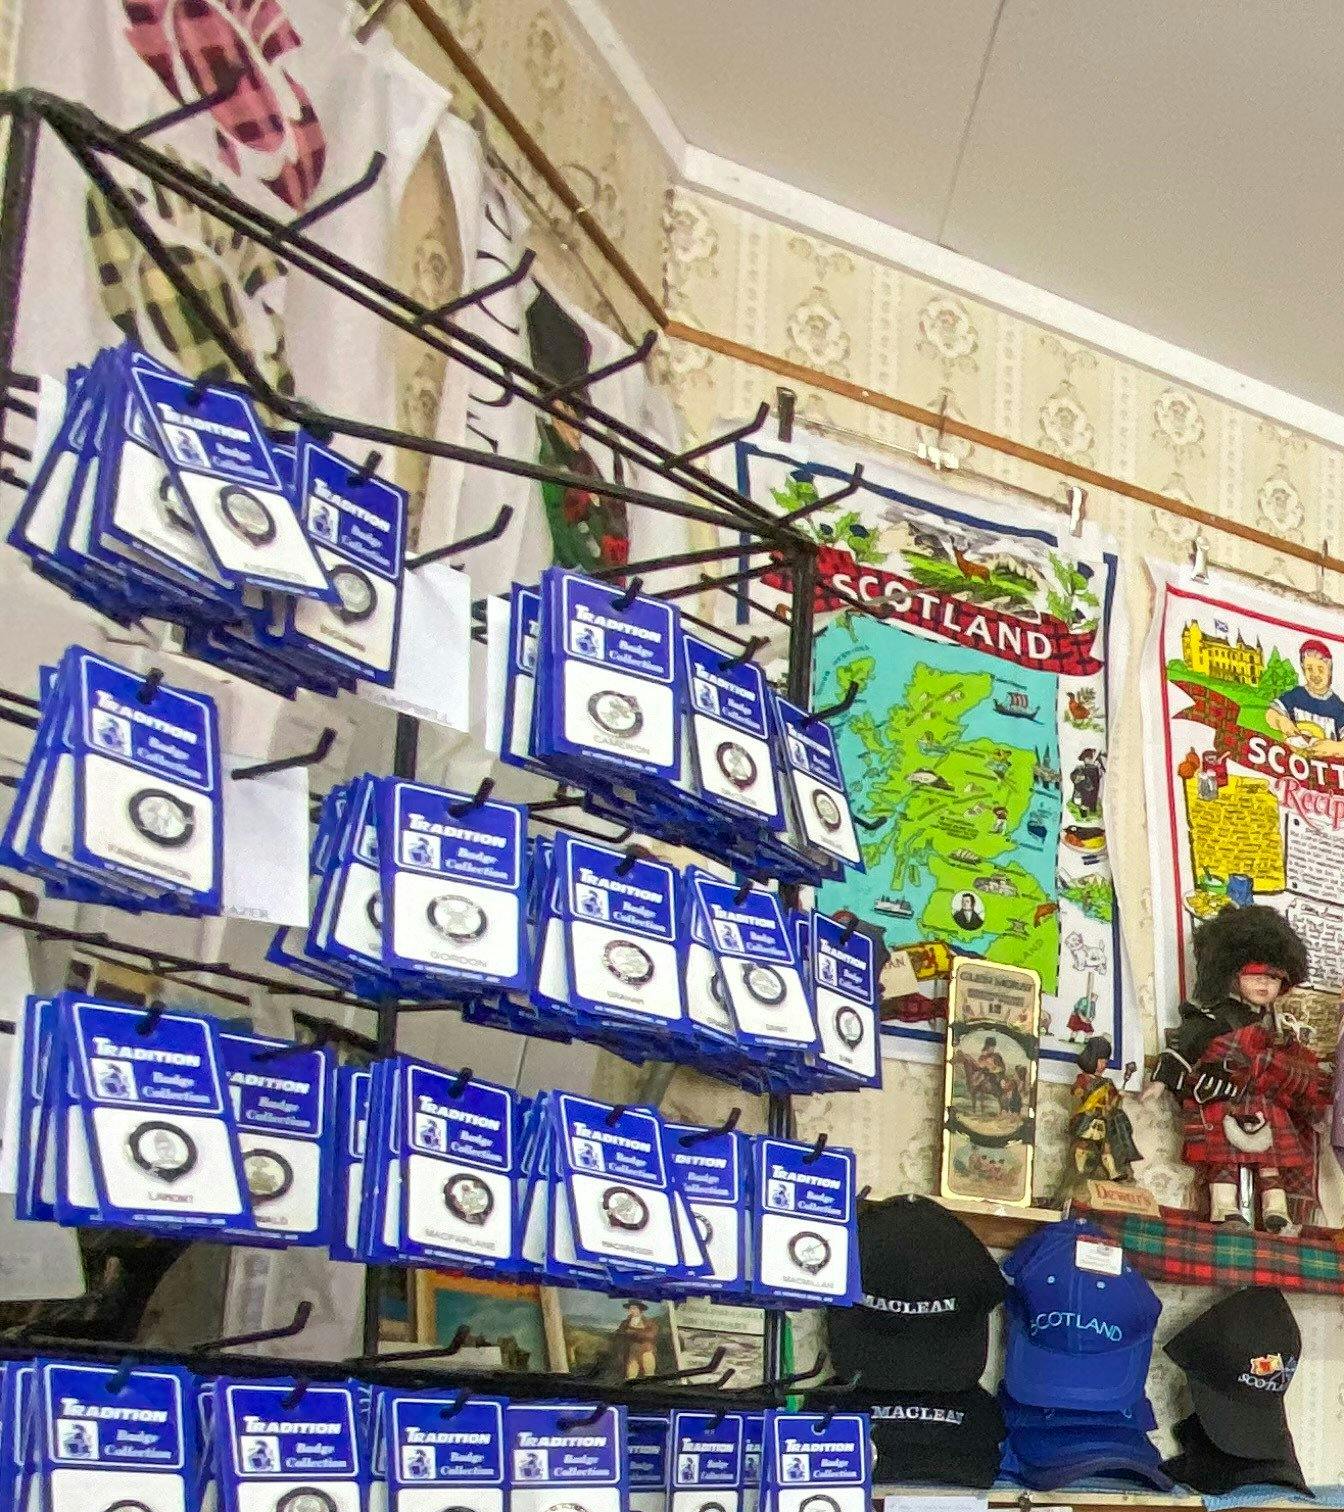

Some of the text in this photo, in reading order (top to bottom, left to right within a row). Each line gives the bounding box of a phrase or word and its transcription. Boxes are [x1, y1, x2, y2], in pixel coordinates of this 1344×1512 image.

[575, 604, 661, 643] TRADITION
[832, 573, 1052, 660] SCOTLAND
[409, 812, 507, 848] TRADITION
[579, 867, 663, 904] TRADITION
[430, 950, 488, 968] GORDON
[92, 1036, 201, 1068] TRADITION
[229, 1071, 310, 1094] ADITION
[418, 1094, 501, 1131] TRADITION
[573, 1121, 651, 1153] TRADITION
[770, 1165, 842, 1190] TRADITION
[863, 1295, 957, 1314] MACLEAN
[1030, 1311, 1122, 1342] SCOTLAND
[60, 1397, 168, 1423] TRADITION
[872, 1405, 964, 1425] MACLEAN
[242, 1415, 342, 1435] TRADITION
[405, 1426, 491, 1445] TRADITION
[517, 1431, 608, 1448] TRADITION
[785, 1438, 855, 1453] TRADITION
